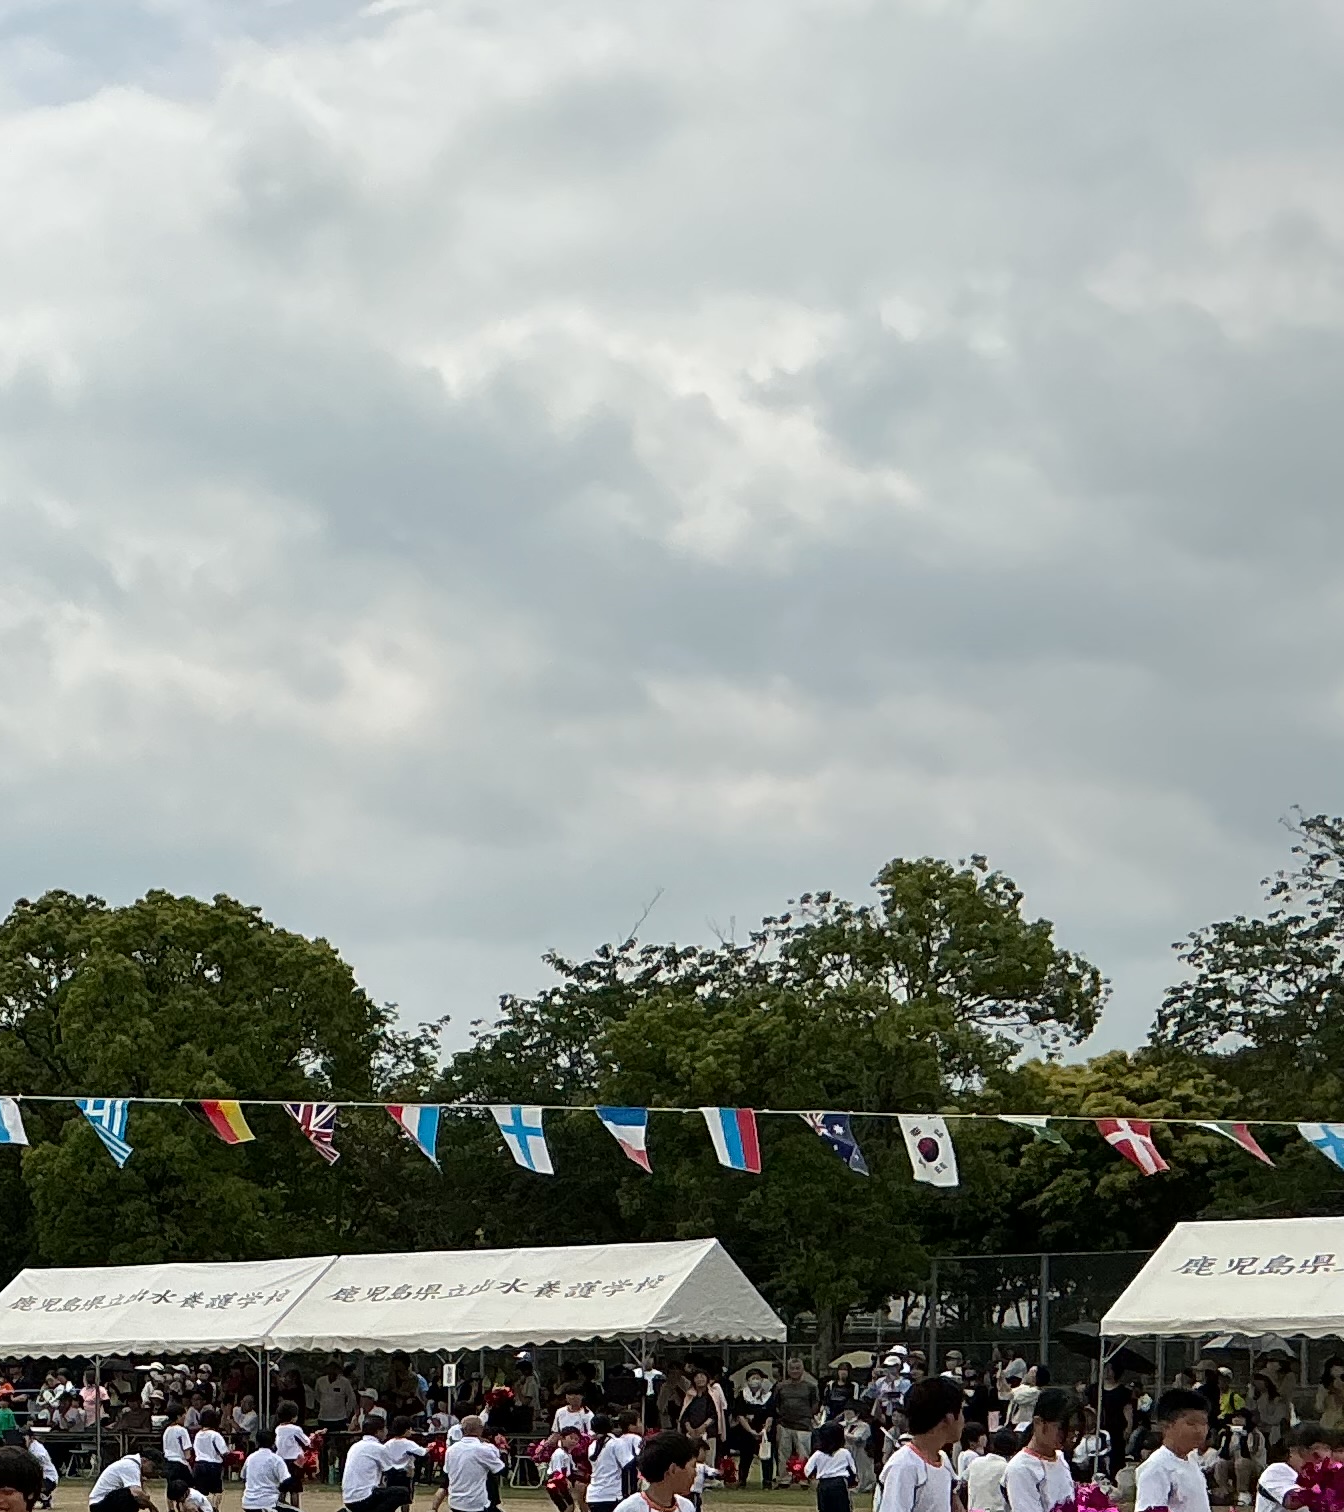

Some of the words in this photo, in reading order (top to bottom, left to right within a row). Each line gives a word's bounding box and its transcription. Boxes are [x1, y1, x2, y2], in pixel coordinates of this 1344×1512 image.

[1173, 1255, 1344, 1275] 鹿児島県
[327, 1275, 665, 1302] 鹿児島県立出水養護学校
[9, 1289, 290, 1312] 鹿児島県立出水養護学校
